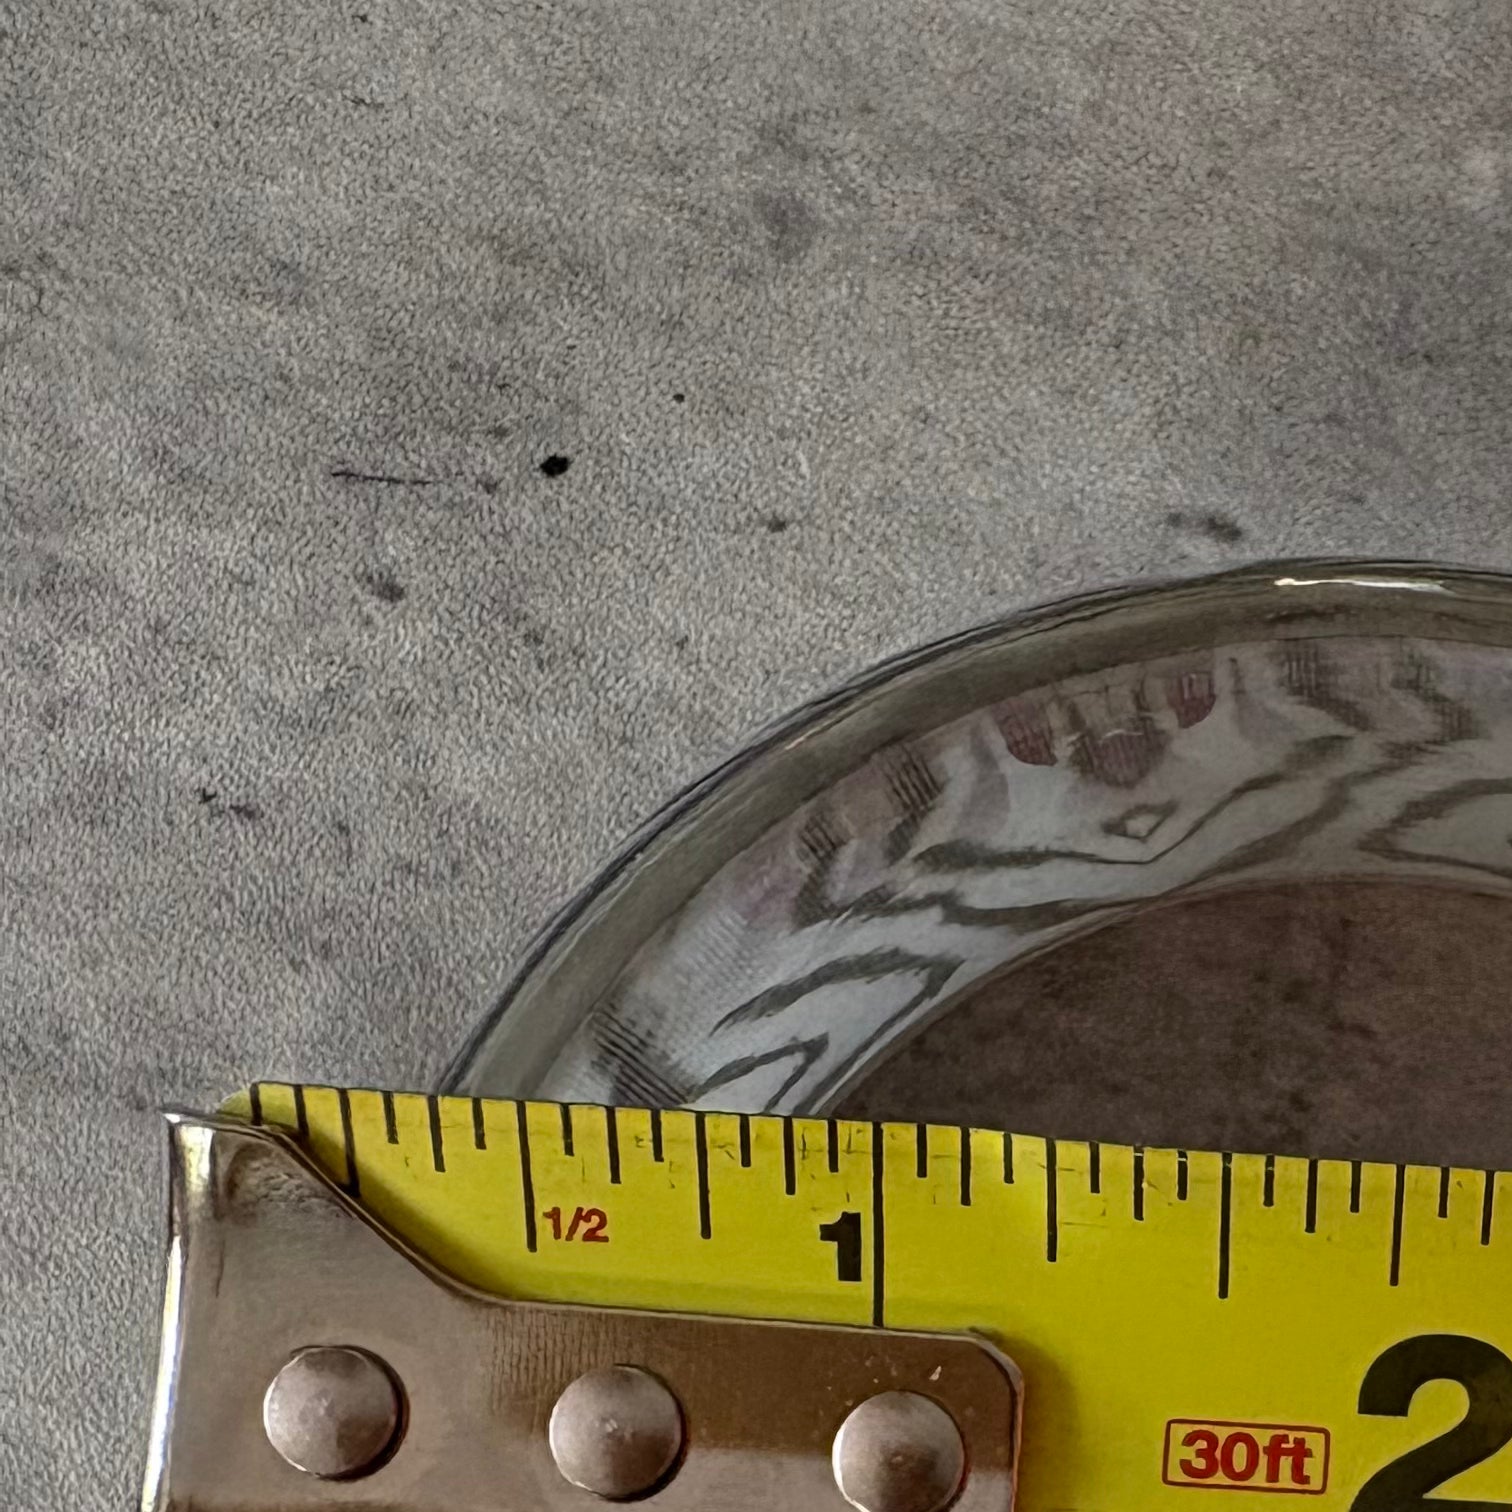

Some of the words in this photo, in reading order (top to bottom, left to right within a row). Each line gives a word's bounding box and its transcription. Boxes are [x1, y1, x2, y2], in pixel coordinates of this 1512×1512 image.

[543, 1208, 609, 1243] 1/2
[819, 1212, 863, 1281] 1
[1179, 1431, 1313, 1485] 30ft
